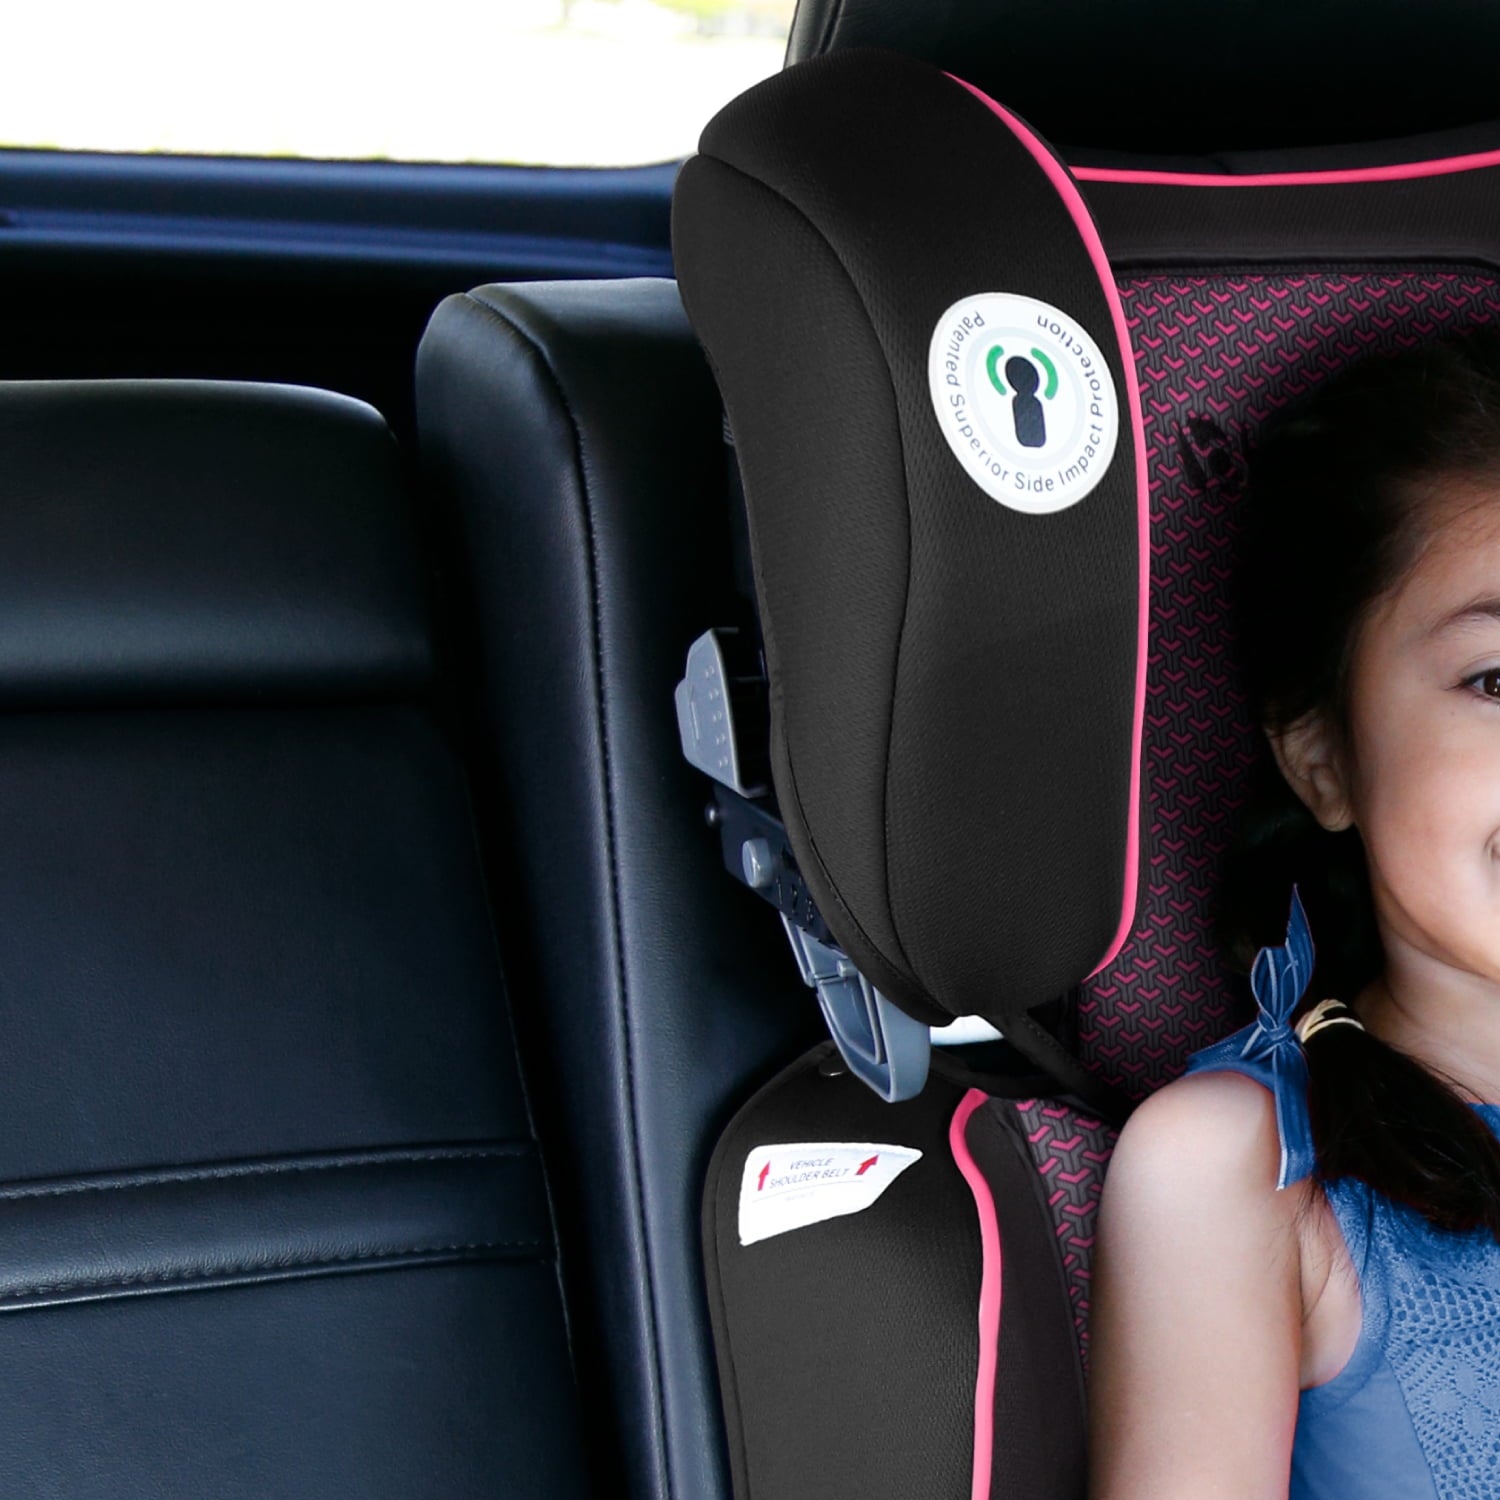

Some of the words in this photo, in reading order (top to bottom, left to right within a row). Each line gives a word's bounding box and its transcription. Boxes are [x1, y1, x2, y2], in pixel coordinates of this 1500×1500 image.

[945, 311, 986, 387] Patented
[1036, 314, 1104, 417] Protection
[950, 394, 1010, 481] Superior
[1058, 425, 1103, 486] Impact
[1014, 471, 1054, 493] Side
[768, 1169, 820, 1189] SHOULDER
[821, 1168, 850, 1179] BELT
[789, 1157, 834, 1170] VEHICLE
